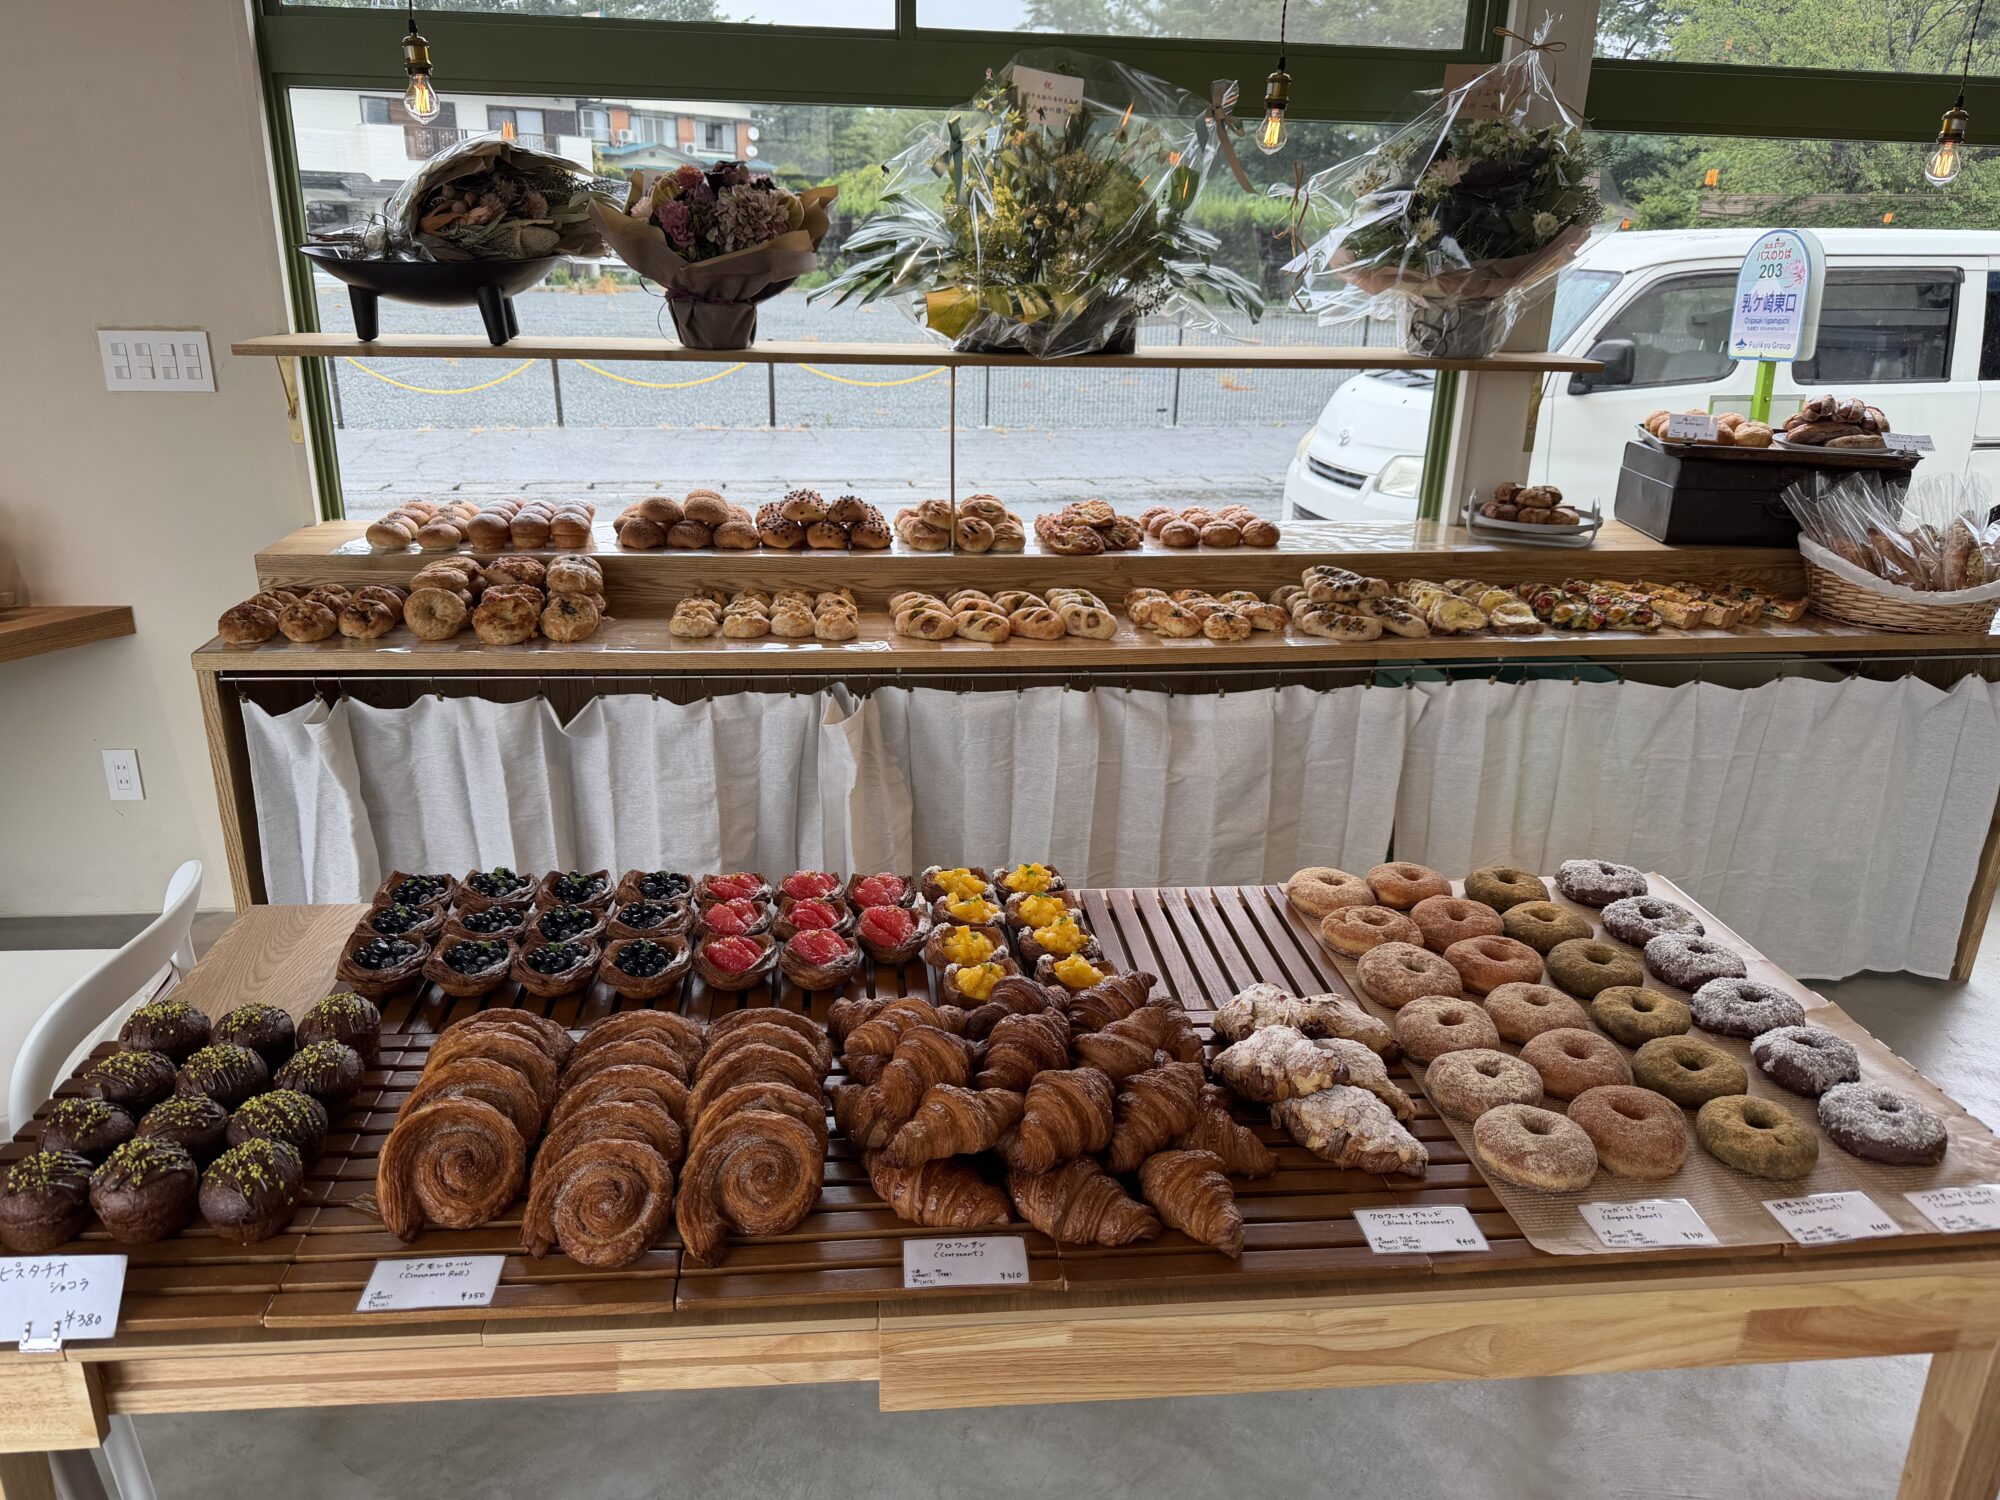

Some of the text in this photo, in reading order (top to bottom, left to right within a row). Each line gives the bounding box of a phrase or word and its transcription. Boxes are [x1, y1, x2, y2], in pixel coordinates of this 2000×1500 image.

[1757, 248, 1793, 261] バスのりば
[1758, 263, 1783, 279] 203
[1748, 340, 1792, 351] Fujikyu Group
[0, 1261, 69, 1282] ピスタチオ
[404, 1260, 473, 1270] シナモンロール
[64, 1310, 102, 1329] ¥380
